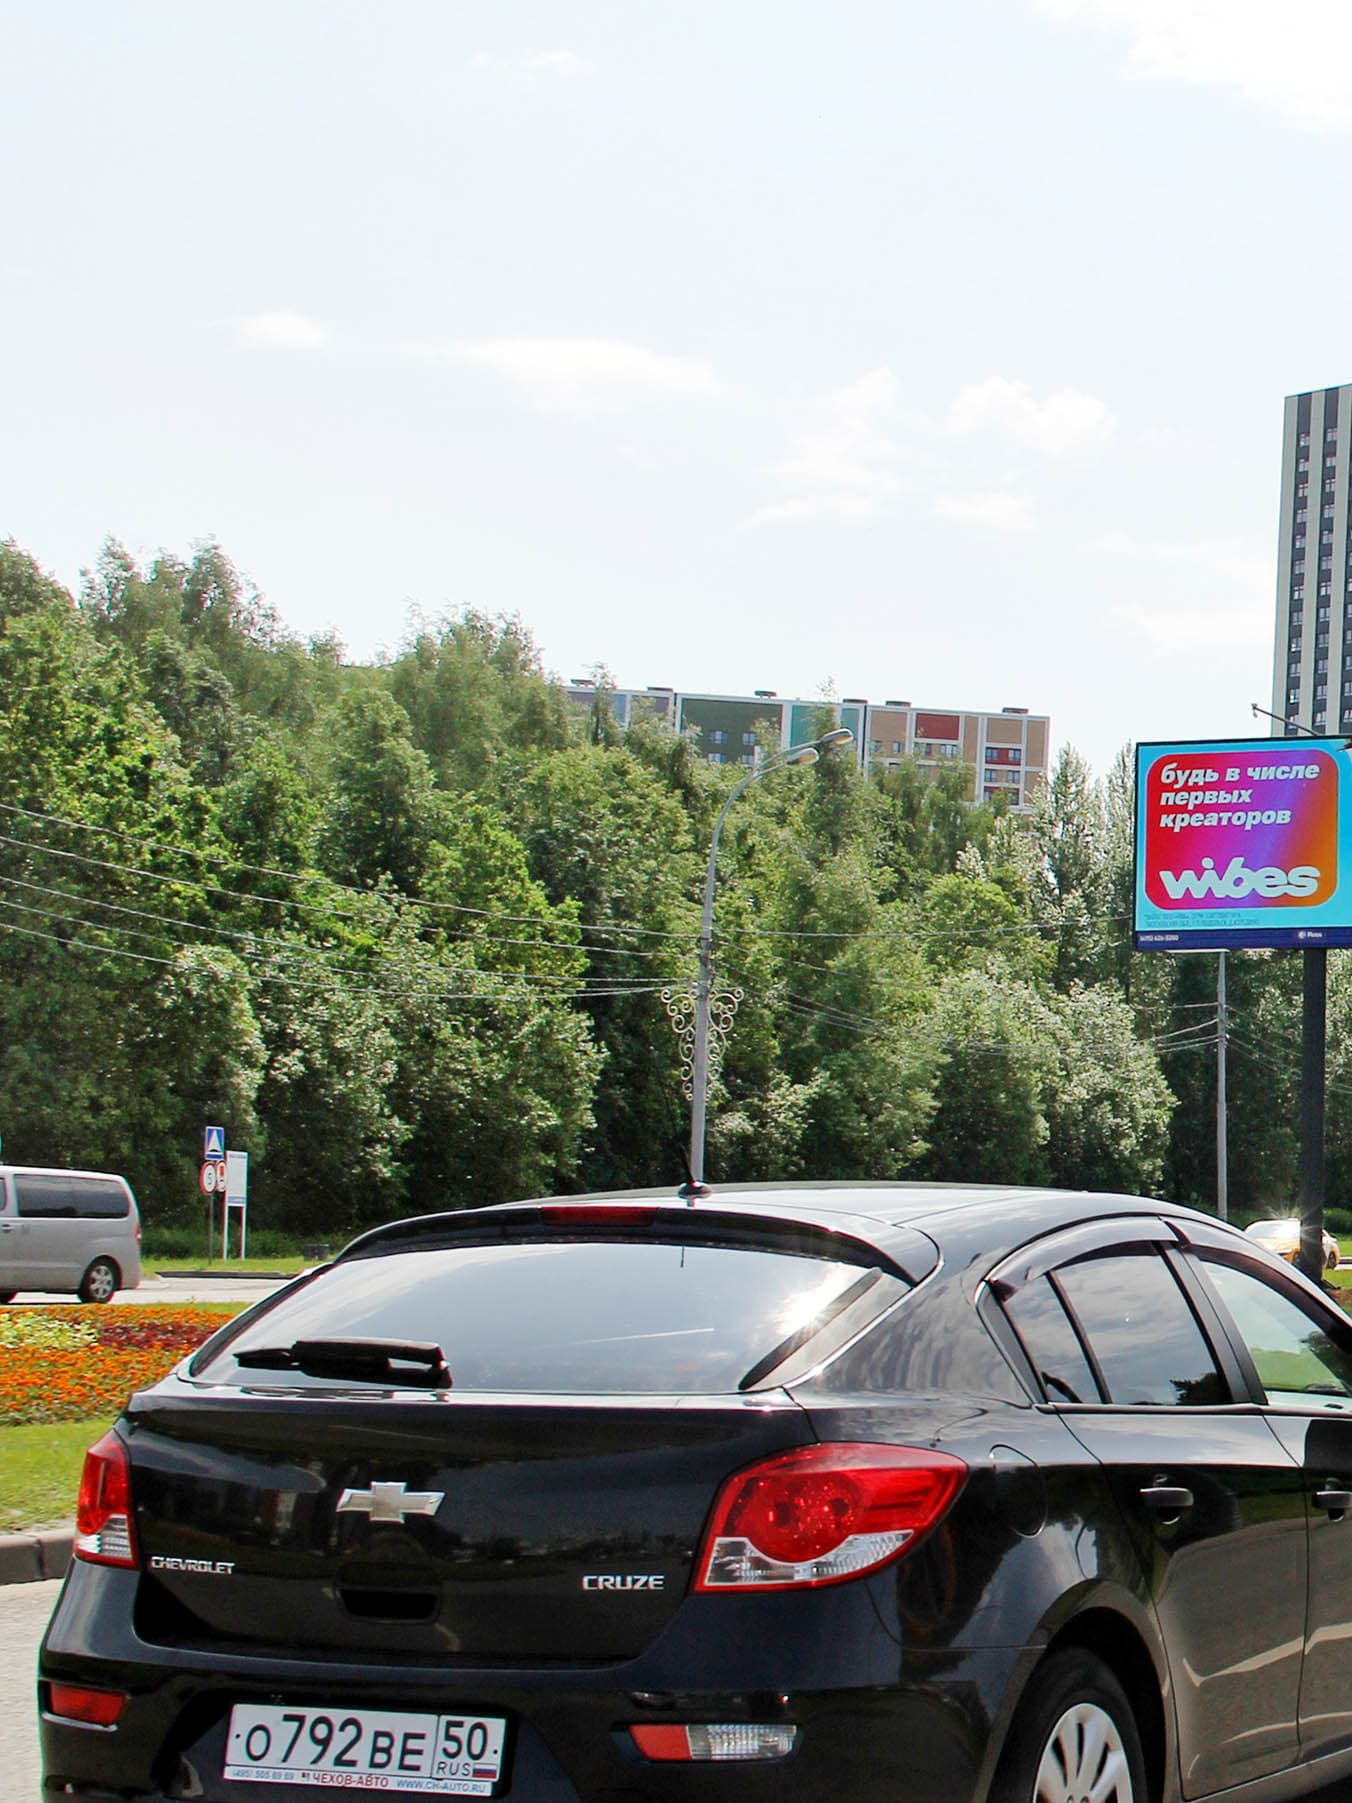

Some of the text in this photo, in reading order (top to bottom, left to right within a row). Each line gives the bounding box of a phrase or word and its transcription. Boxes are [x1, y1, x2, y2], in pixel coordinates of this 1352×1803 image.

[1160, 763, 1321, 788] будь в числе
[1160, 788, 1252, 810] первых
[1160, 808, 1292, 832] креаторов
[1159, 857, 1321, 899] wibes
[151, 1556, 235, 1575] CHEVROLET
[582, 1575, 665, 1590] CRUZE
[441, 1720, 489, 1762] 50
[312, 1772, 389, 1788] ЧЕХОВ-АВТО
[436, 1762, 472, 1777] RUS
